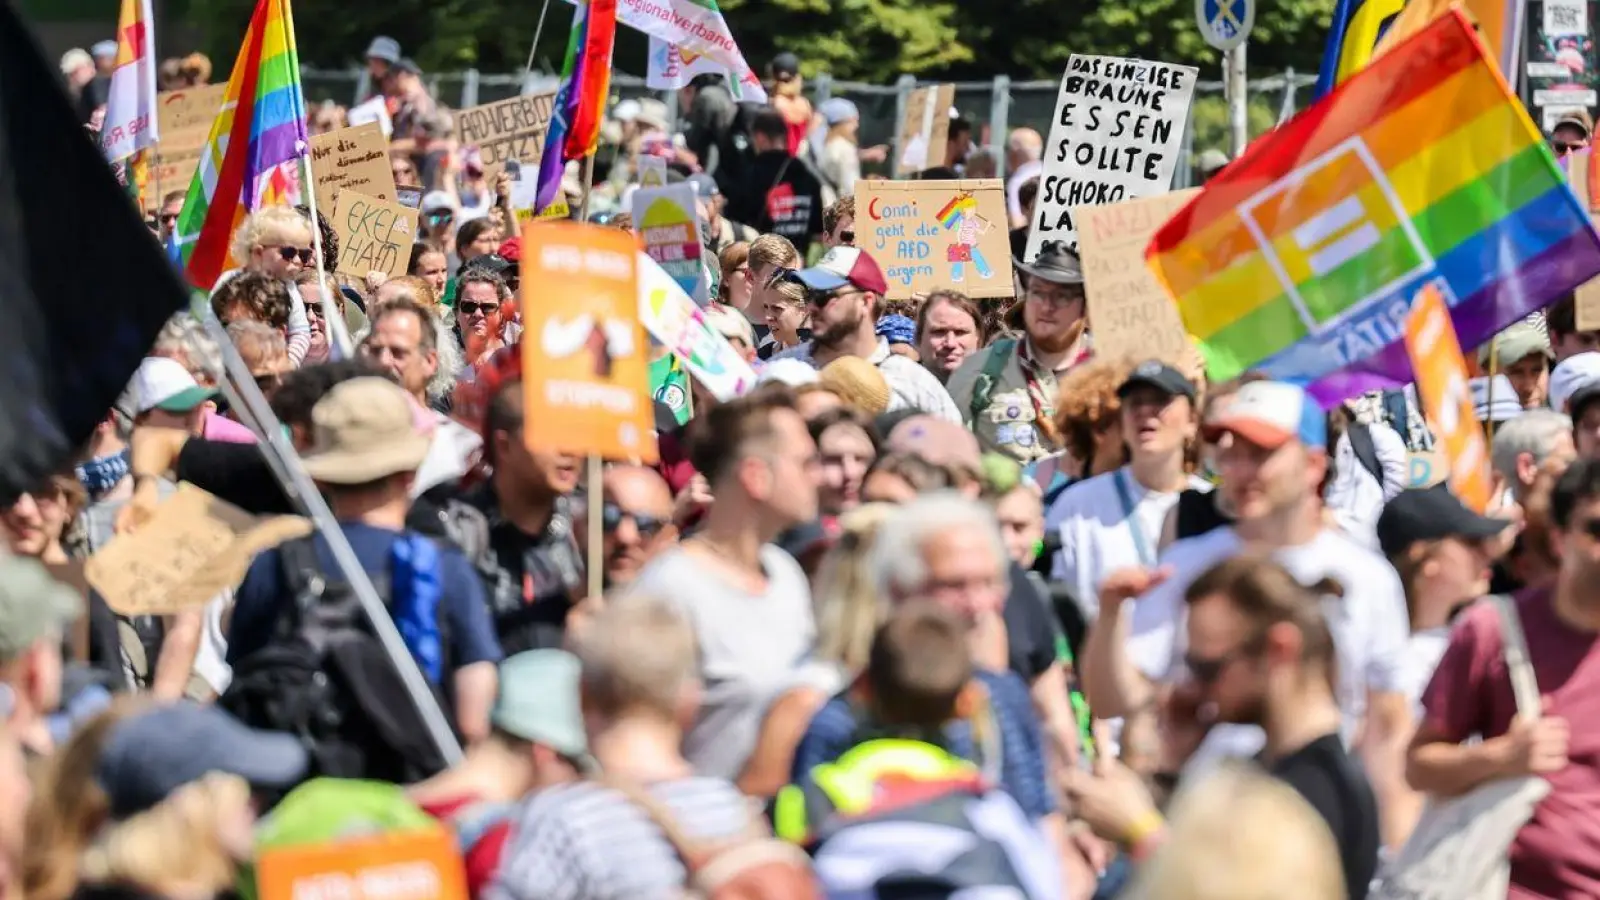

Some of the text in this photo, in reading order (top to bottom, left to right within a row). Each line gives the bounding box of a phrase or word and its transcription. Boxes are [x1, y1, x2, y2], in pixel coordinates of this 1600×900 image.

[1072, 58, 1184, 89] DAS EINZIGE
[1066, 76, 1166, 111] BRAUNE
[1060, 103, 1172, 144] ESSEN
[312, 140, 357, 161] Nur die
[1057, 139, 1164, 180] SOLLTE
[869, 197, 918, 221] Conni
[348, 201, 402, 248] EKEL
[875, 221, 939, 249] geht die
[897, 240, 930, 259] AfD
[887, 264, 933, 286] ärgern
